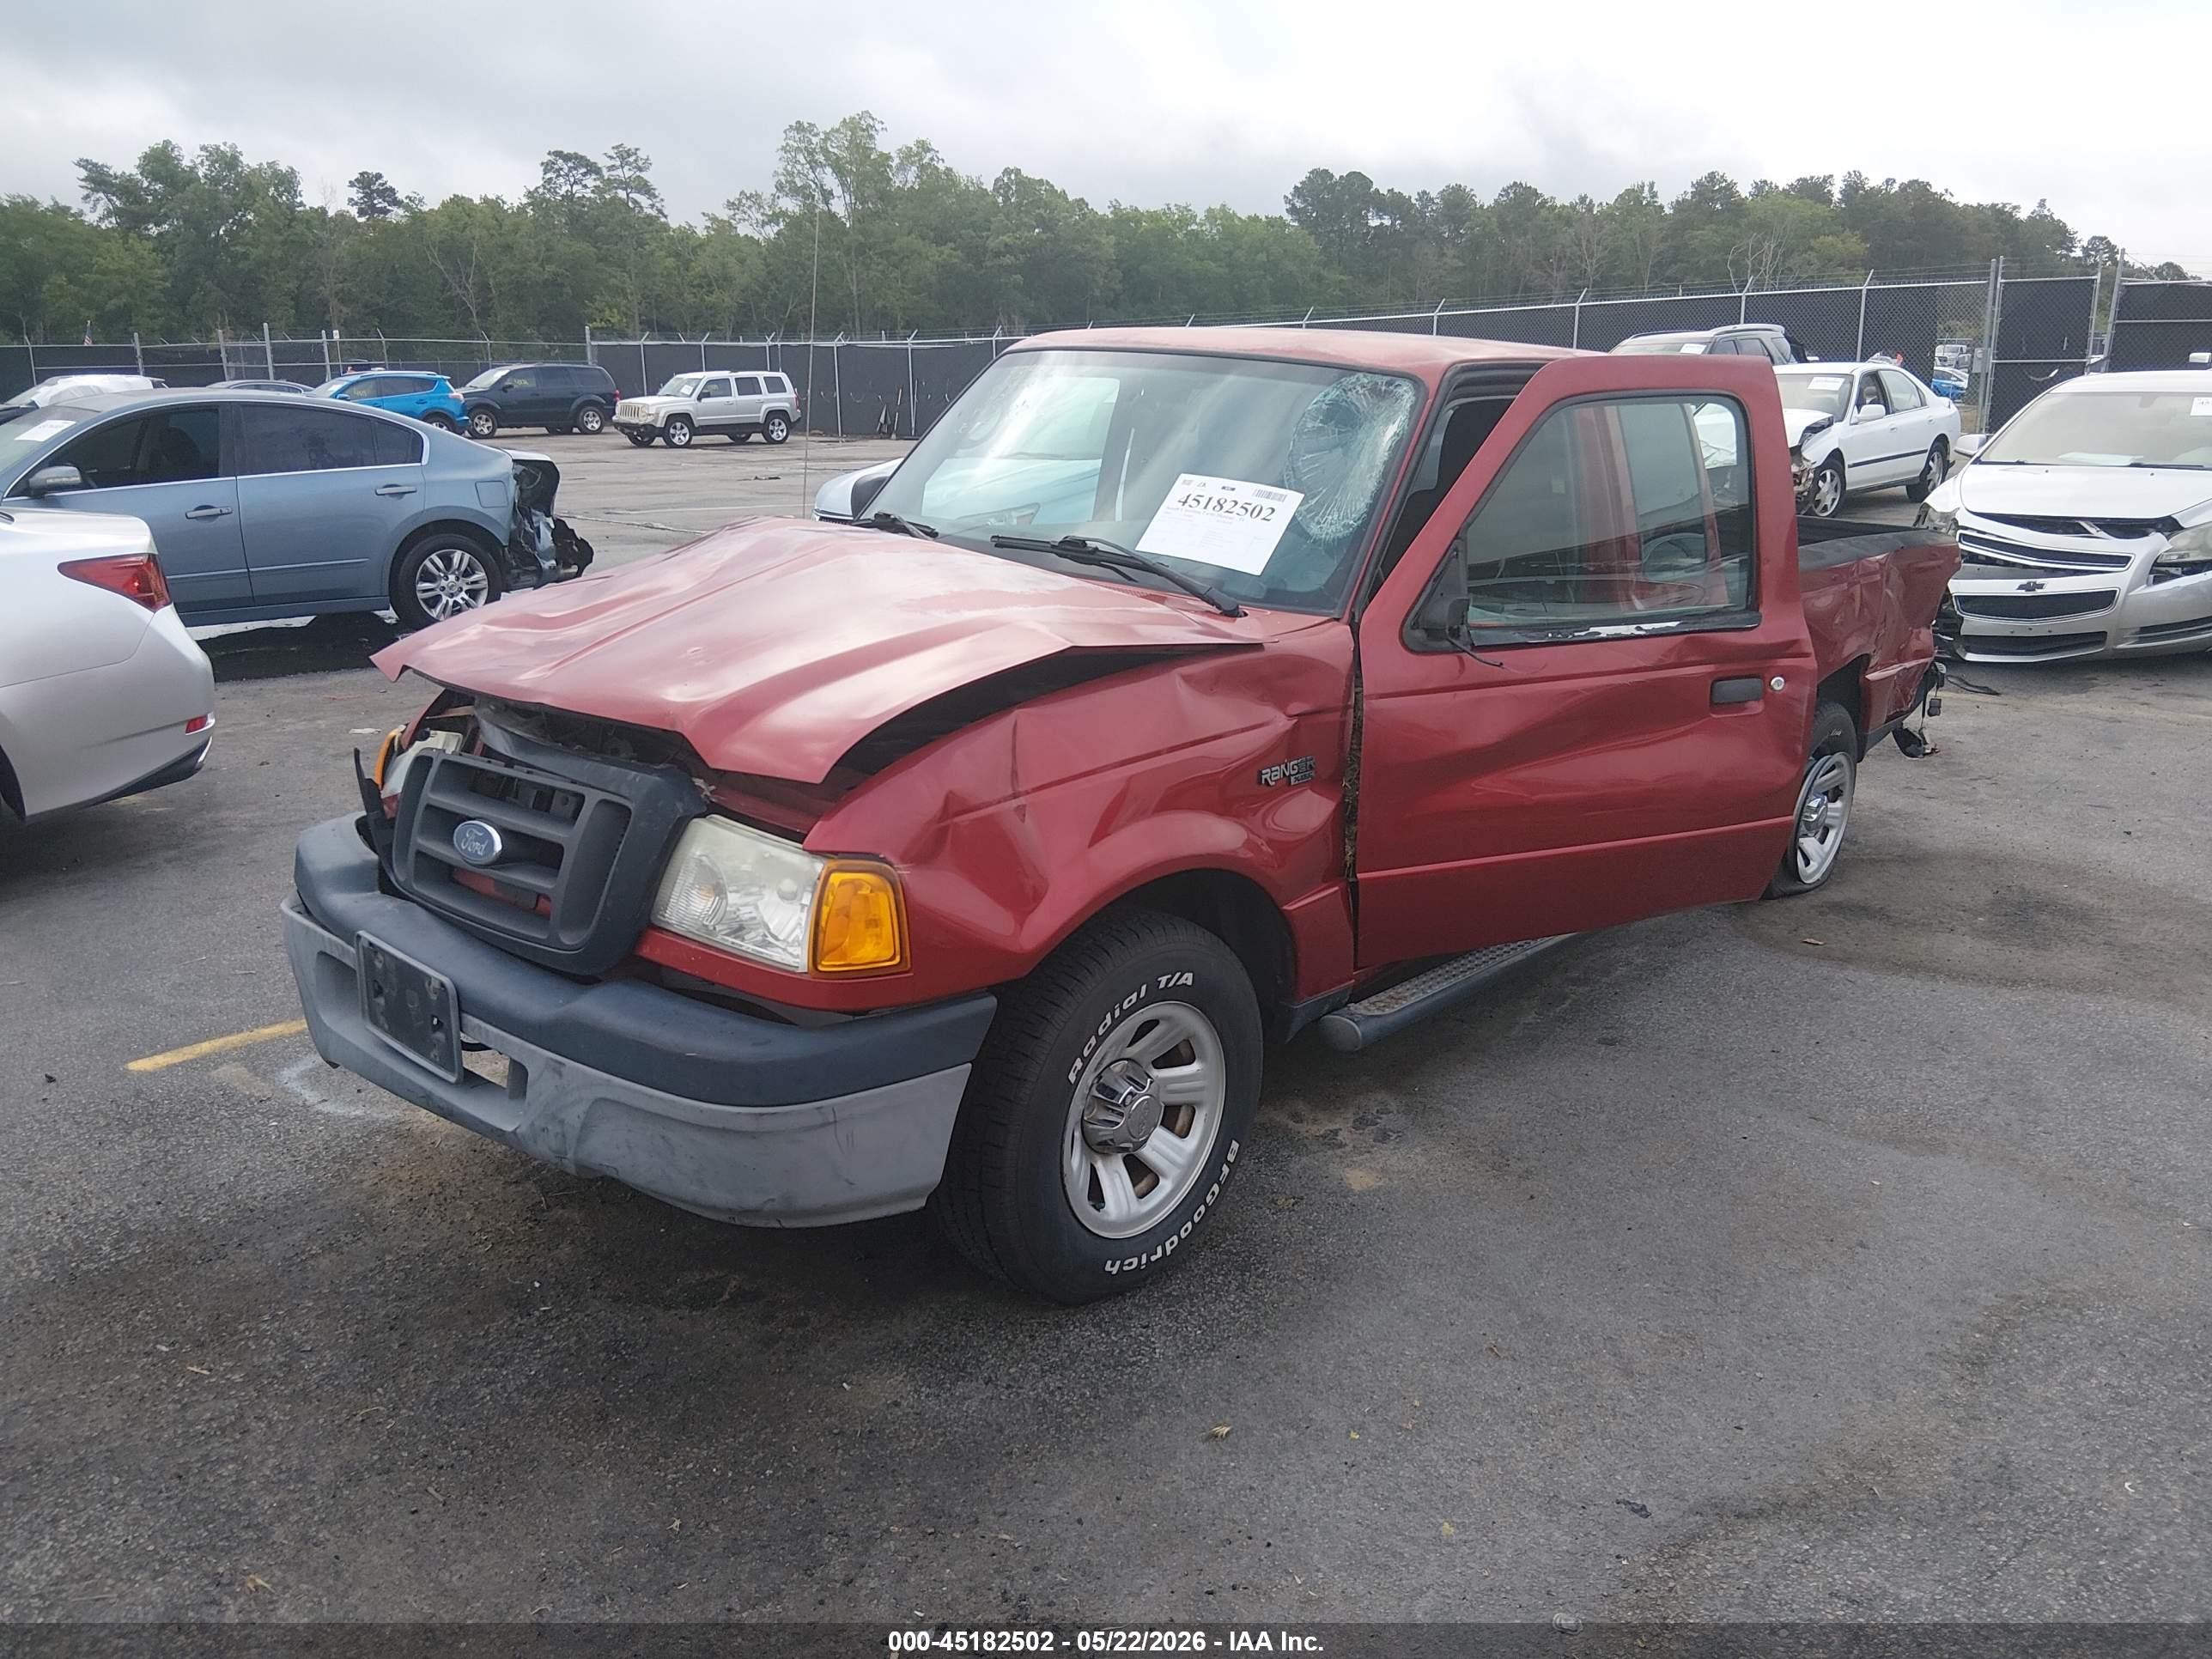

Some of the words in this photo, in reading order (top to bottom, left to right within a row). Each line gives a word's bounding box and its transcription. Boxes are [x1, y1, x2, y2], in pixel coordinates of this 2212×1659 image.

[1177, 493, 1276, 522] 45182502
[460, 827, 489, 856] Ford
[1067, 983, 1147, 1085] Radial
[1156, 971, 1194, 989] T/A
[1103, 1139, 1241, 1275] BFGoodrich
